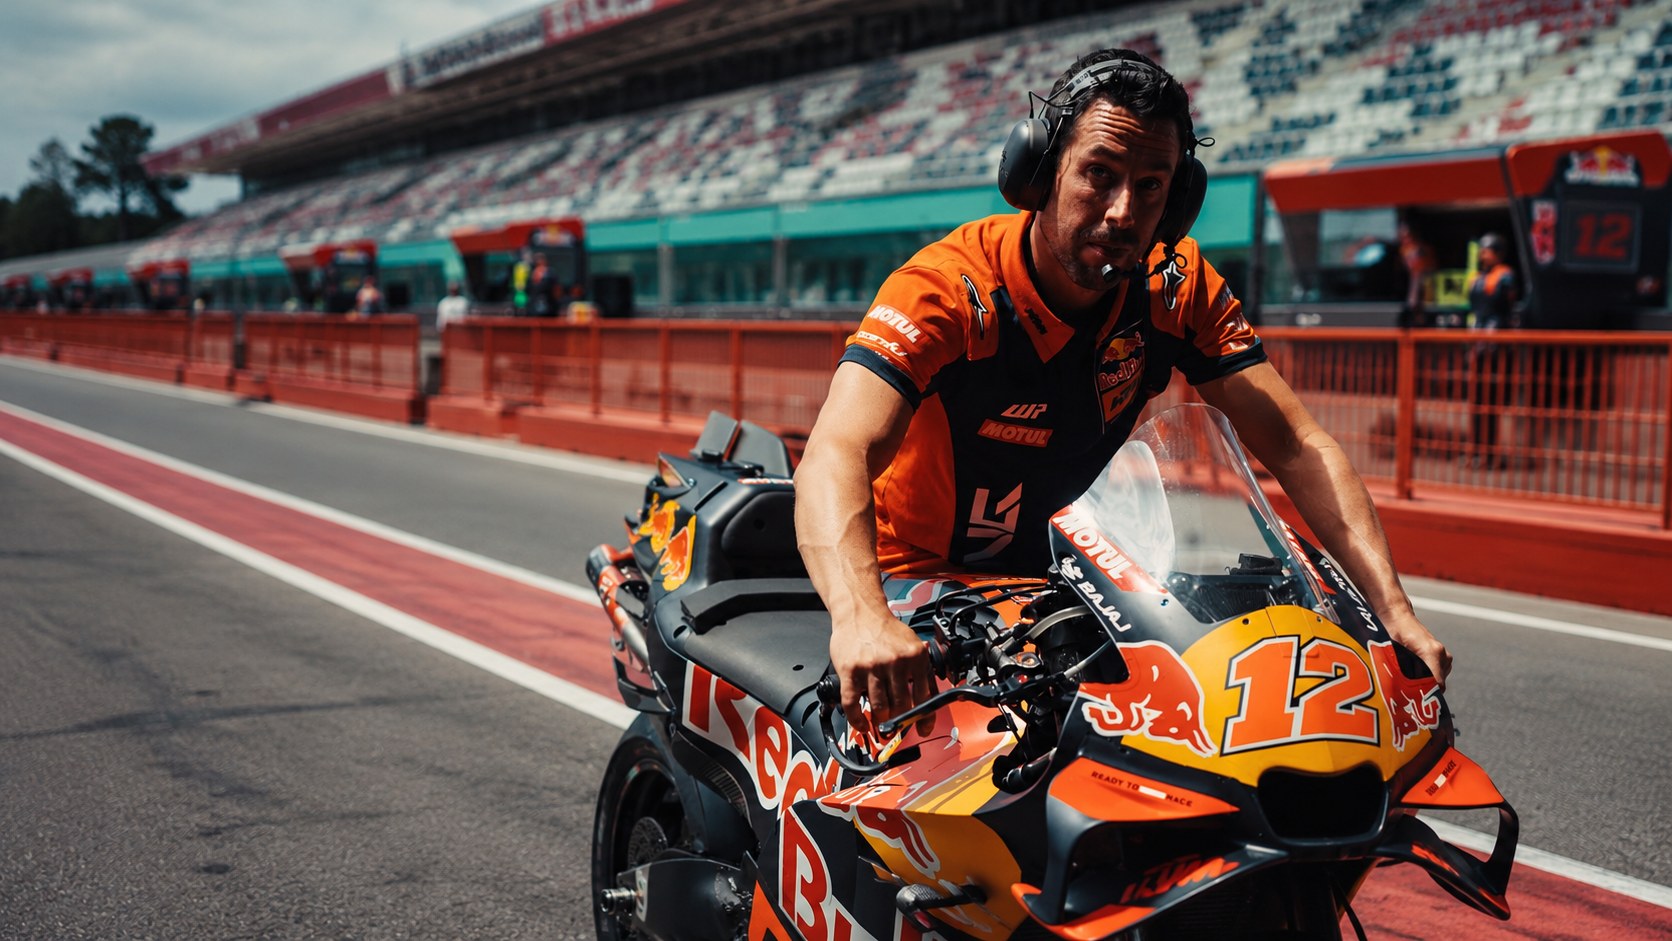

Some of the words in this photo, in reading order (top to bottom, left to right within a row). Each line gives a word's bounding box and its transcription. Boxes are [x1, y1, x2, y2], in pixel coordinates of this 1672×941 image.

[1576, 213, 1633, 262] 12
[867, 305, 921, 343] MOTUL
[982, 422, 1047, 445] MOTUL
[1052, 512, 1133, 580] MOTUL
[1077, 581, 1132, 632] BAJAJ
[1220, 635, 1380, 757] 12
[1091, 771, 1124, 786] READY
[1127, 781, 1140, 791] TO
